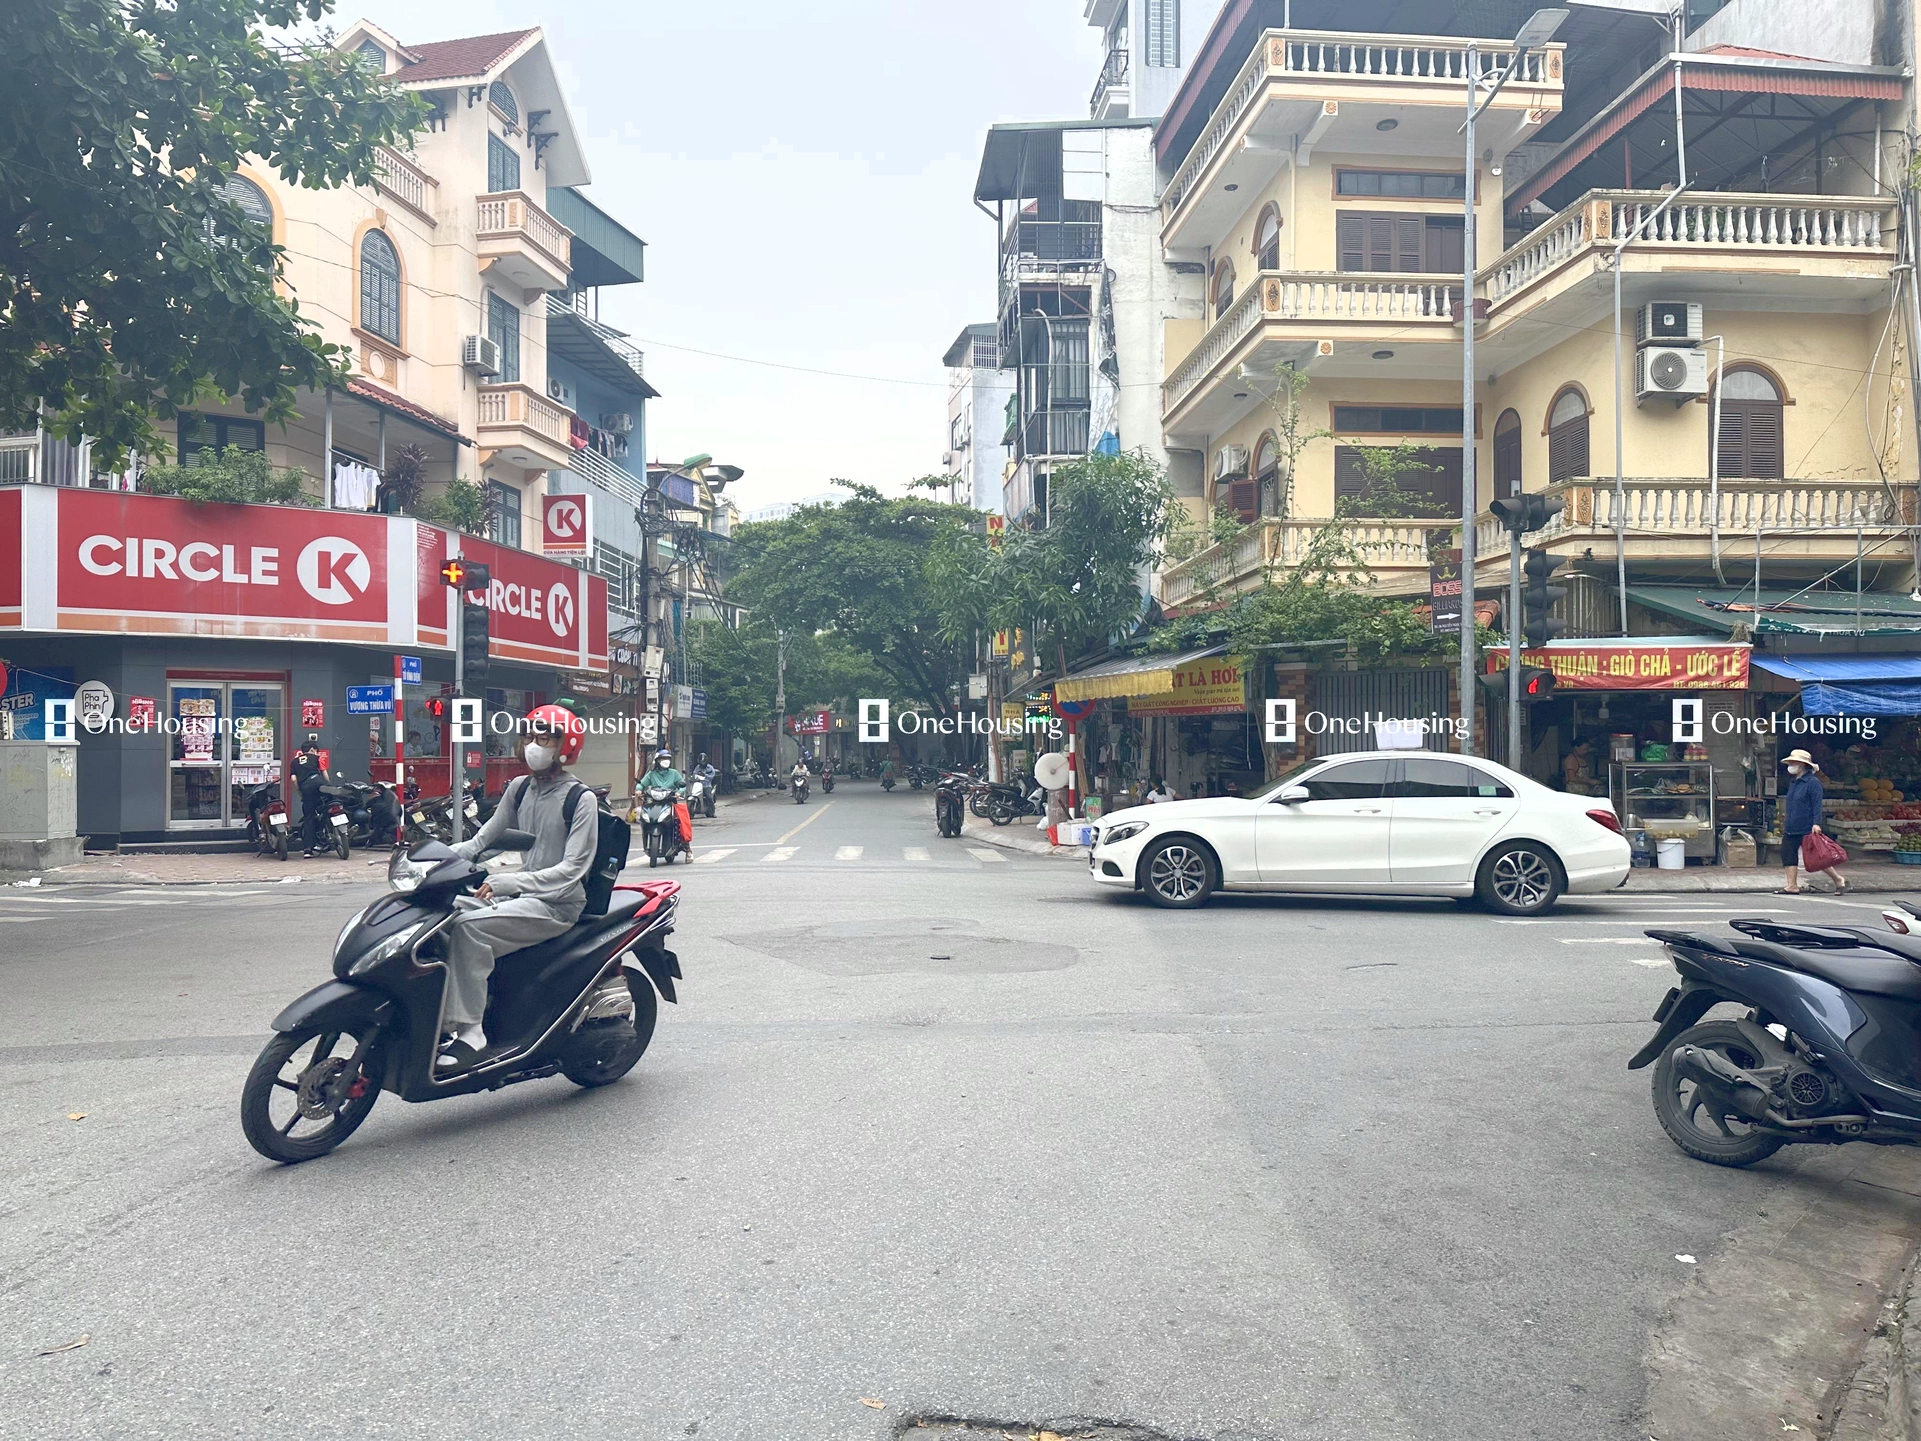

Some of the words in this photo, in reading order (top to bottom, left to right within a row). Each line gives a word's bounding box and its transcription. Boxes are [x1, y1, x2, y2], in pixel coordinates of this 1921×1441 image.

[552, 505, 581, 537] K
[78, 534, 279, 586] CIRCLE
[308, 541, 369, 604] K
[1433, 579, 1462, 597] BOSS
[549, 585, 573, 637] K
[1549, 651, 1598, 681] THUẬN
[1609, 649, 1635, 676] GIÒ
[1640, 648, 1671, 676] CHẢ
[1686, 650, 1719, 677] ƯỚC
[1723, 647, 1741, 677] LỄ
[1188, 666, 1207, 687] LÀ
[84, 692, 100, 702] Pha
[366, 688, 383, 696] PHỐ
[1227, 695, 1240, 703] CAO
[84, 701, 101, 710] Phin
